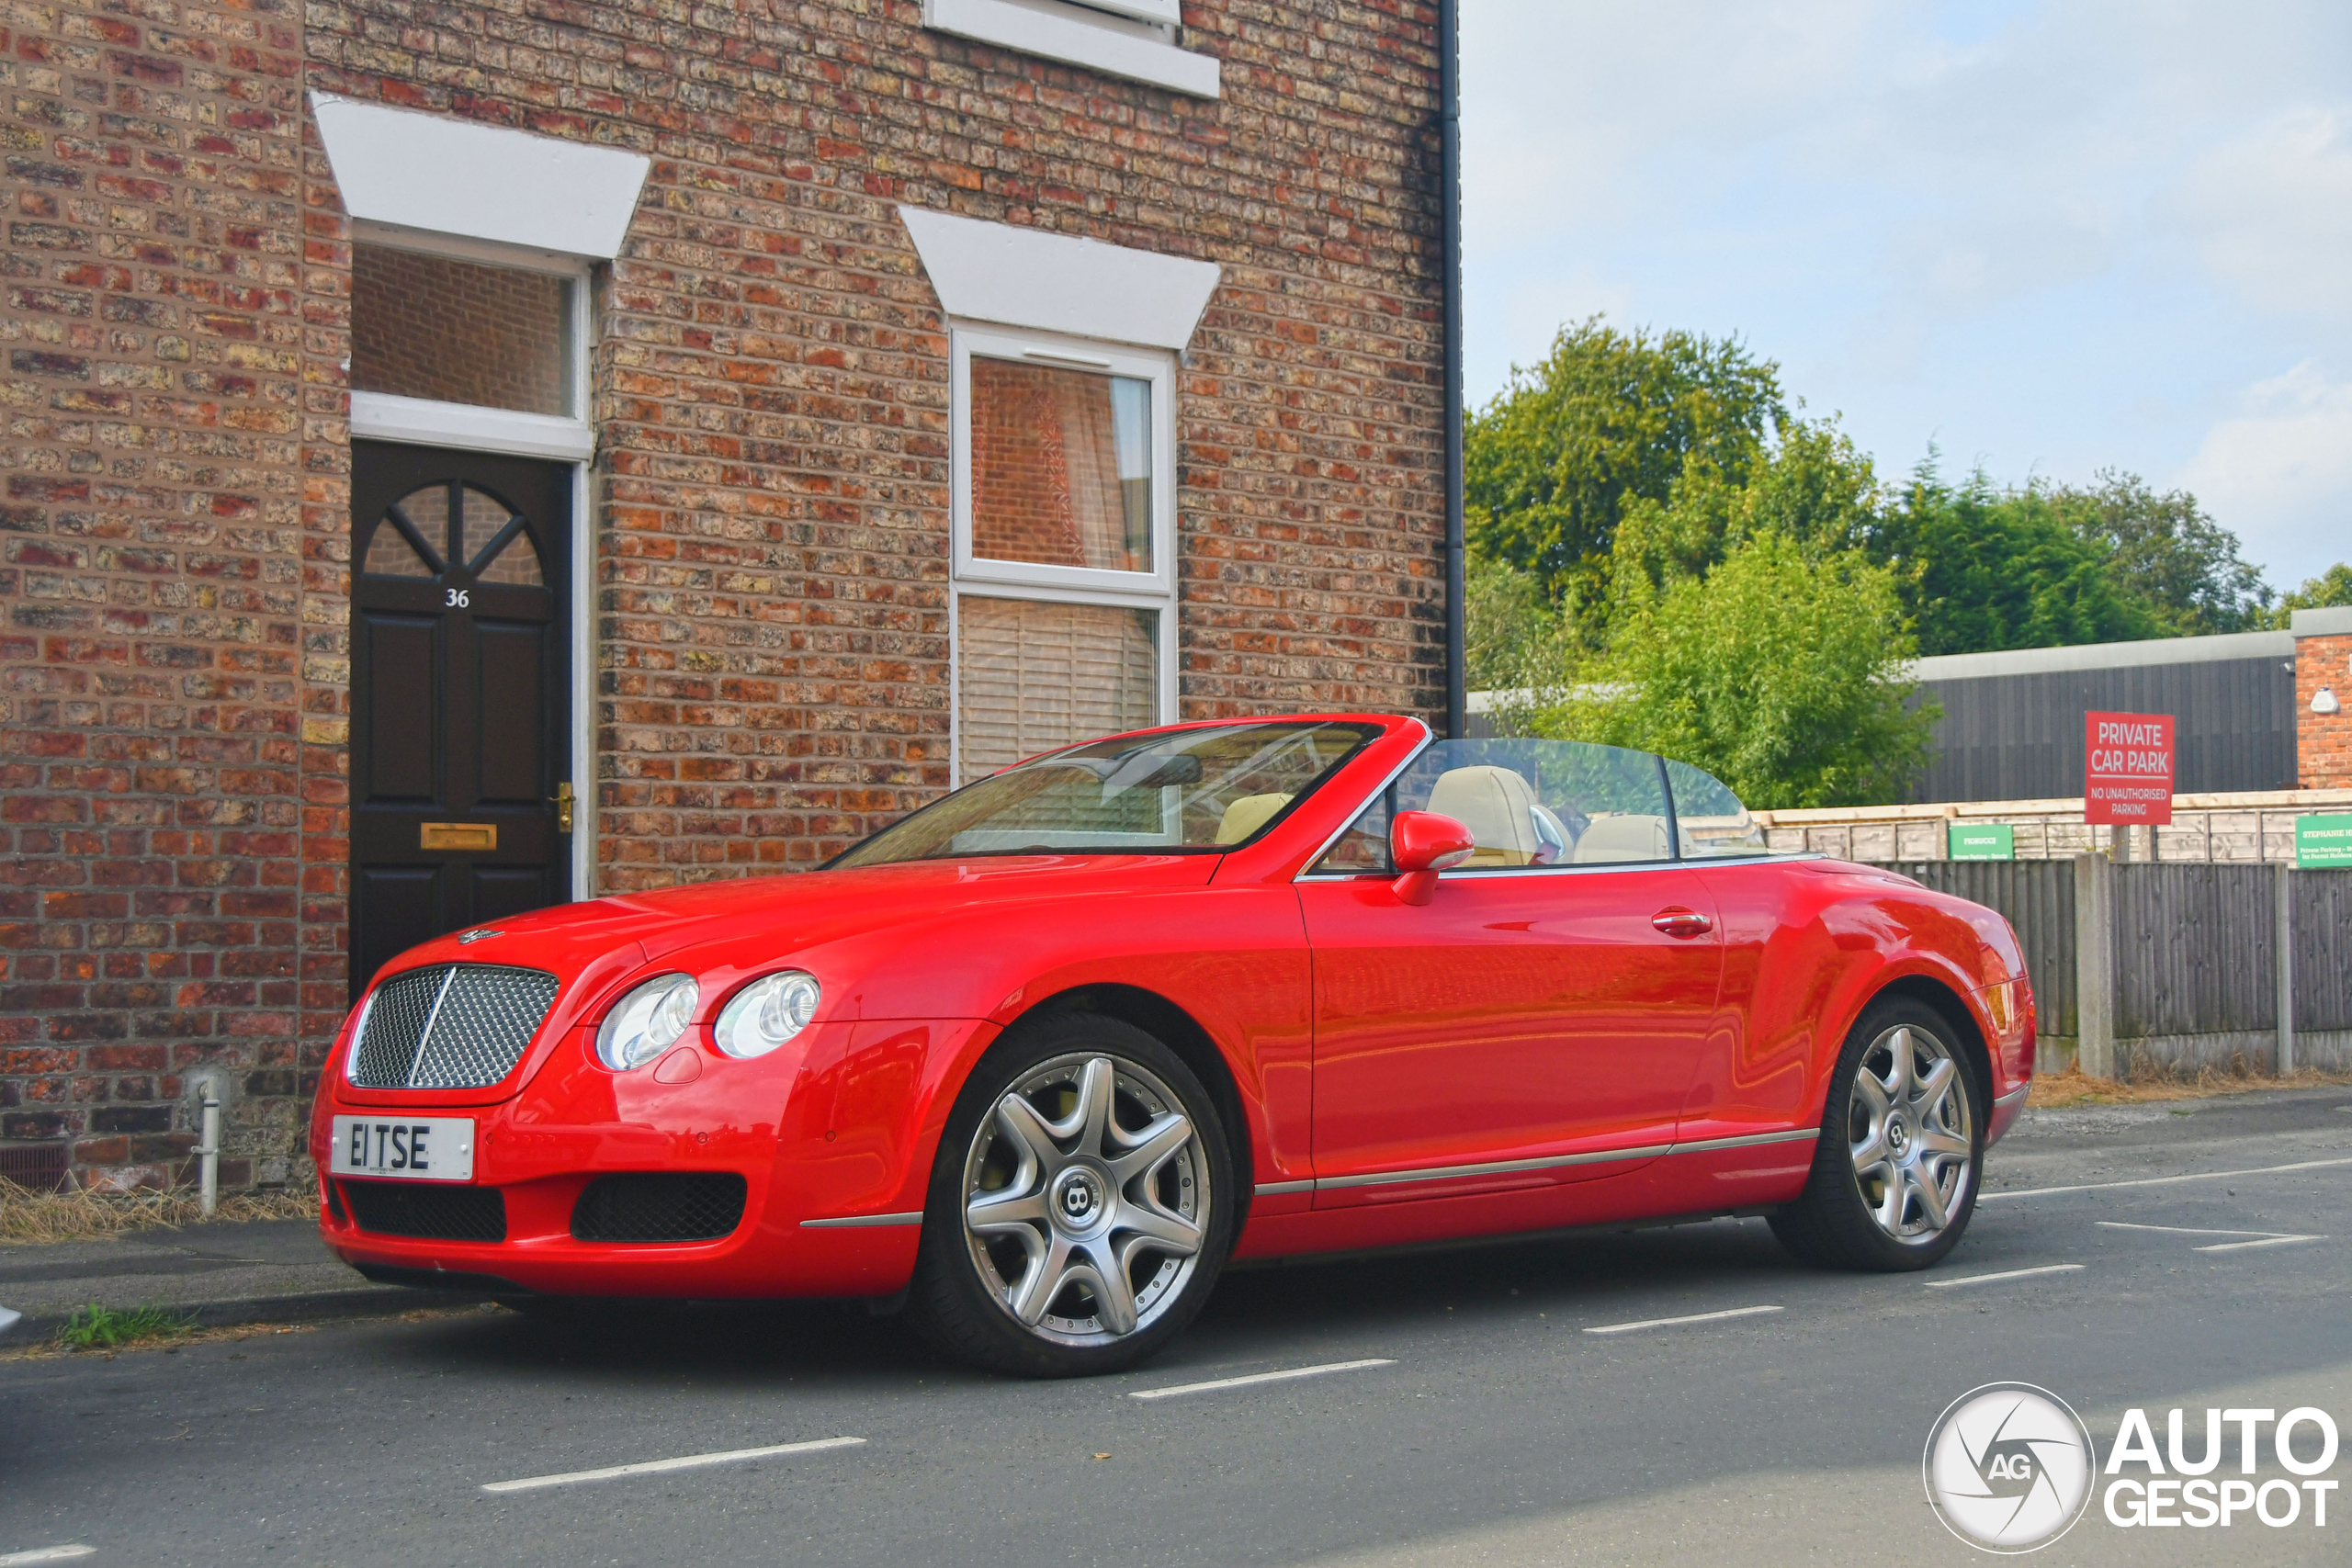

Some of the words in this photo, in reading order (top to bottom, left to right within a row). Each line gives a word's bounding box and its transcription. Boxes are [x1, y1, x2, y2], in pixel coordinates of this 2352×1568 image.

[446, 588, 469, 608] 36
[2098, 722, 2162, 746] PRIVATE
[2091, 749, 2123, 772] CAR
[2127, 750, 2168, 773] PARK
[2091, 787, 2104, 799] NO
[2106, 788, 2166, 800] UNAUTHORISED
[2111, 804, 2146, 815] PARKING
[2302, 829, 2345, 838] STEPHANIE
